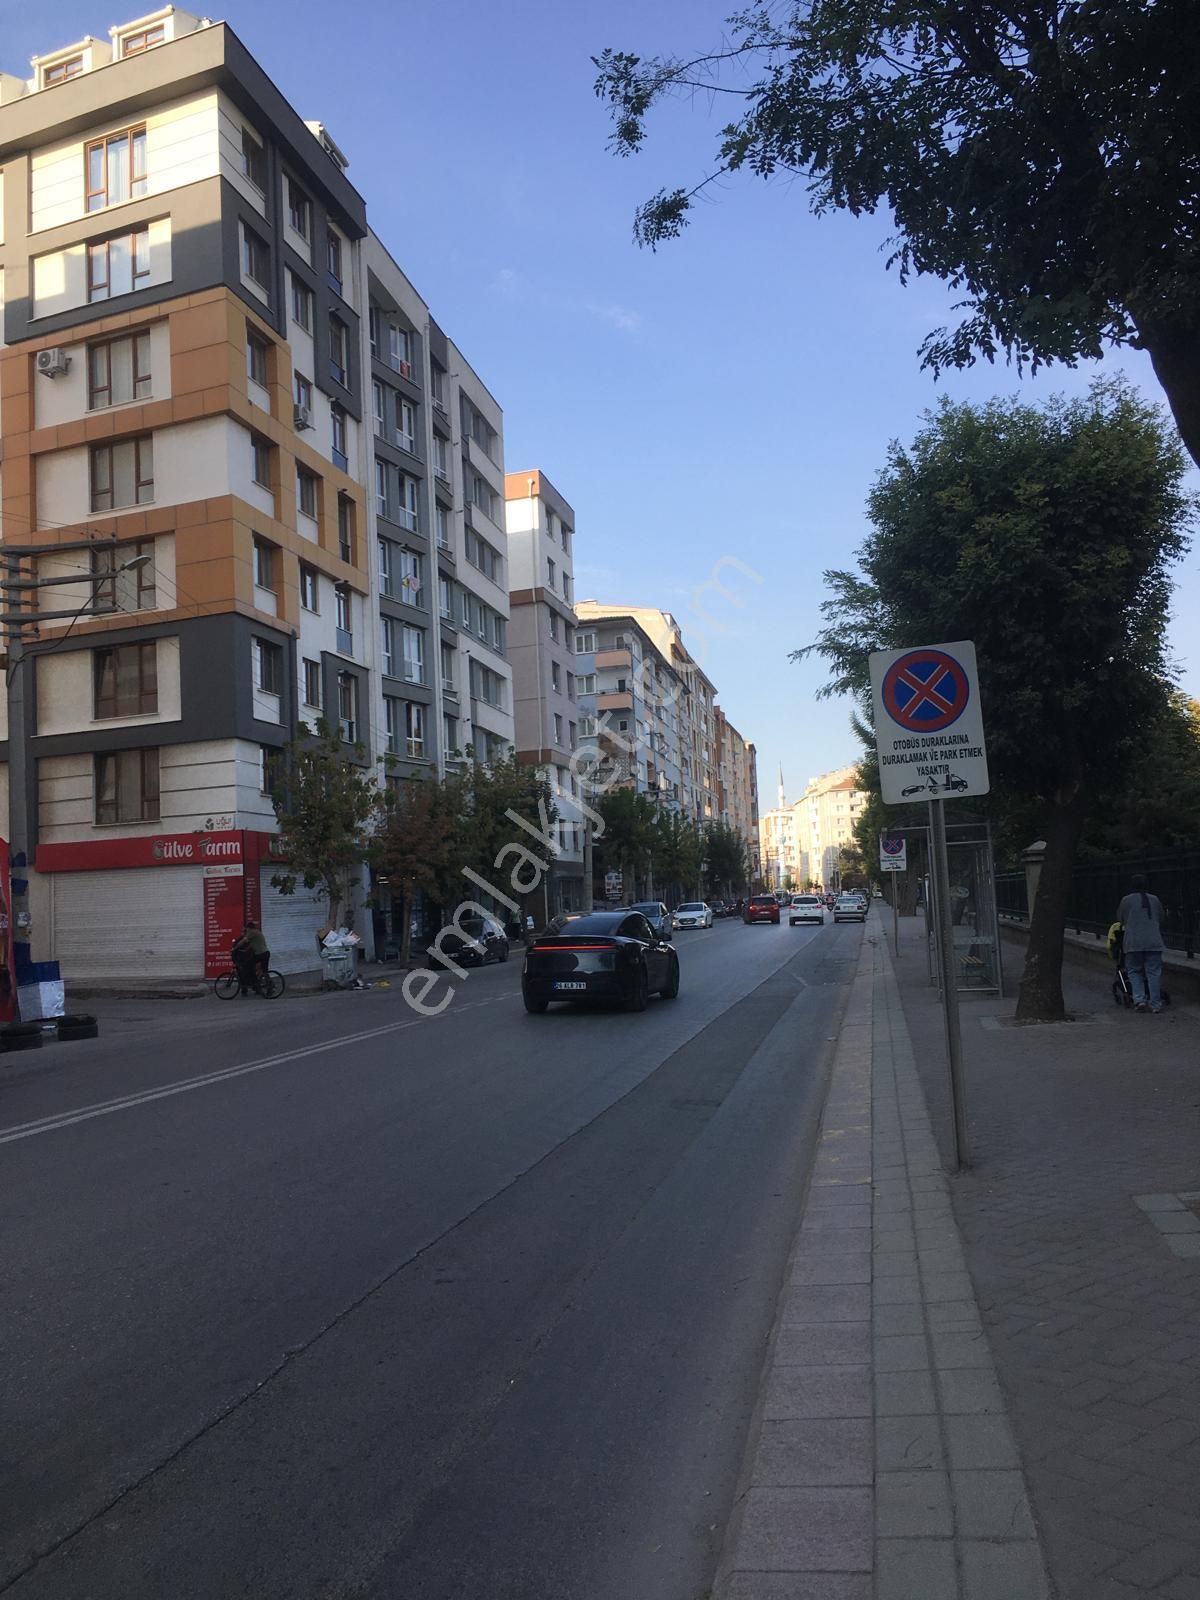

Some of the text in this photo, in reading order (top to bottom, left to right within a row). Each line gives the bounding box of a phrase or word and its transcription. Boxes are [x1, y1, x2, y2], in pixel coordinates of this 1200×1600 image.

[893, 734, 969, 751] OTOBÜS DURAKLARINA
[882, 747, 983, 766] DURAKLAMAK VE PARK ETMEK
[916, 764, 950, 777] YASAKTIR
[153, 837, 241, 860] Gülve Tarım
